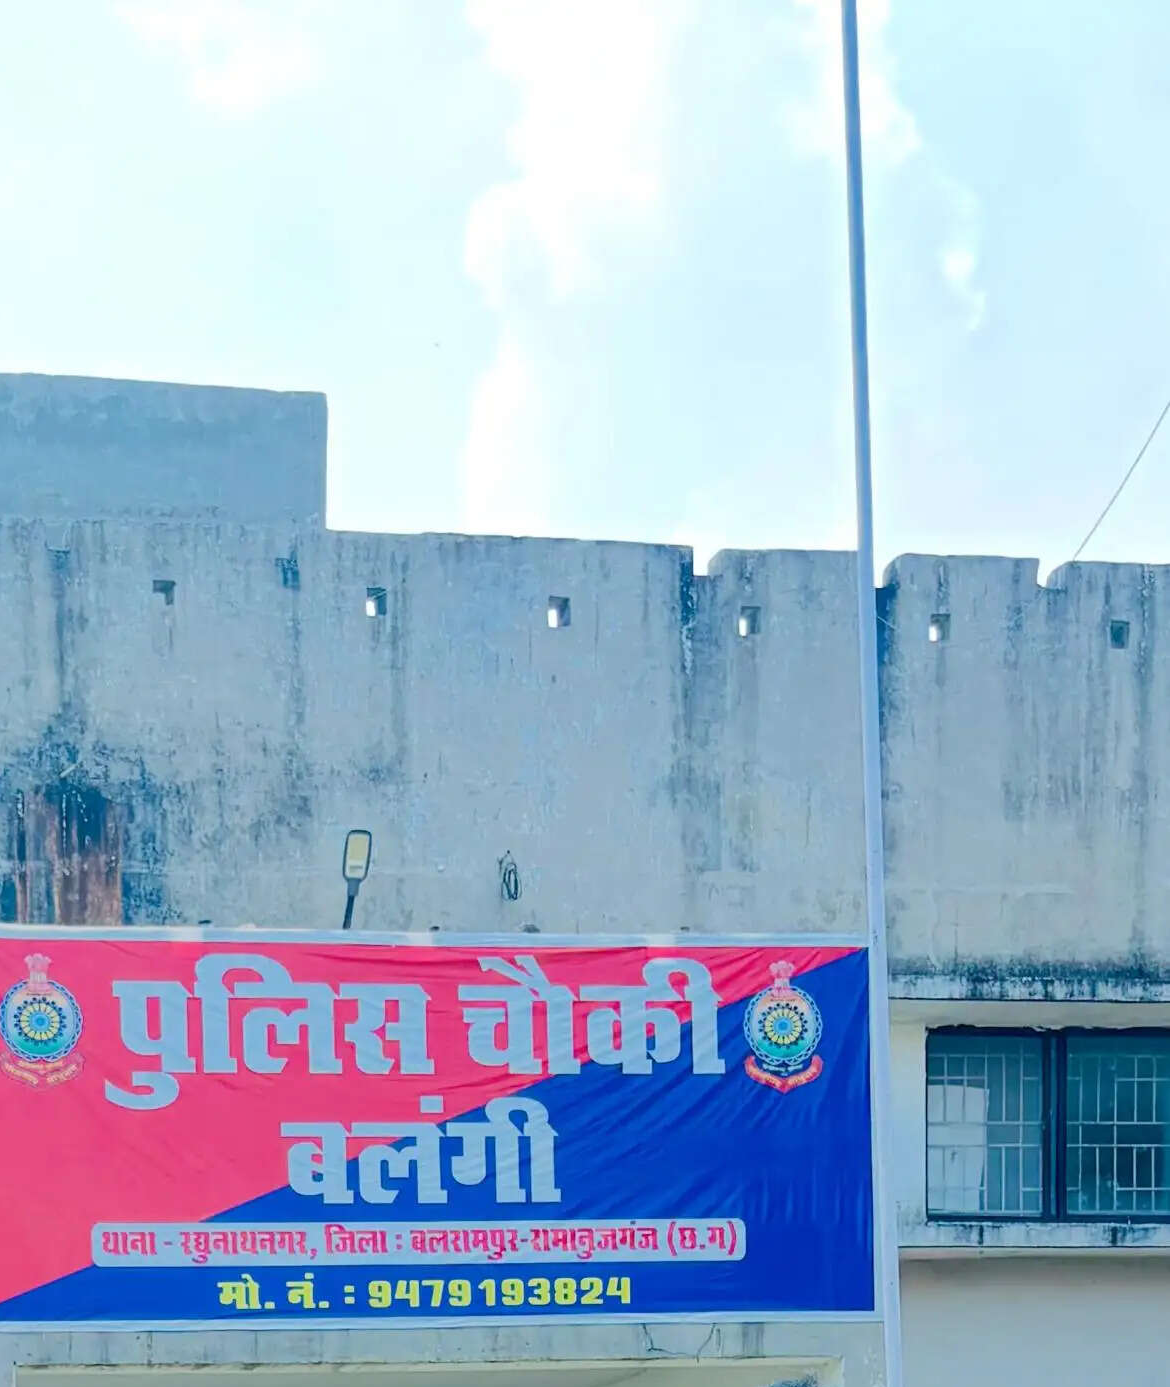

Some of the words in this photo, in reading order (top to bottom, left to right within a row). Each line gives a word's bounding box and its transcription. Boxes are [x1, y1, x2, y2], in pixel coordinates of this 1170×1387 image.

[105, 954, 432, 1109] पुलिस
[463, 955, 727, 1076] चौकी
[280, 1095, 562, 1204] बलंगी
[102, 1231, 157, 1256] थाना
[324, 1224, 388, 1255] जिला
[217, 1273, 275, 1309] मो.
[286, 1272, 329, 1309] नं.
[368, 1277, 631, 1308] 9479193824
